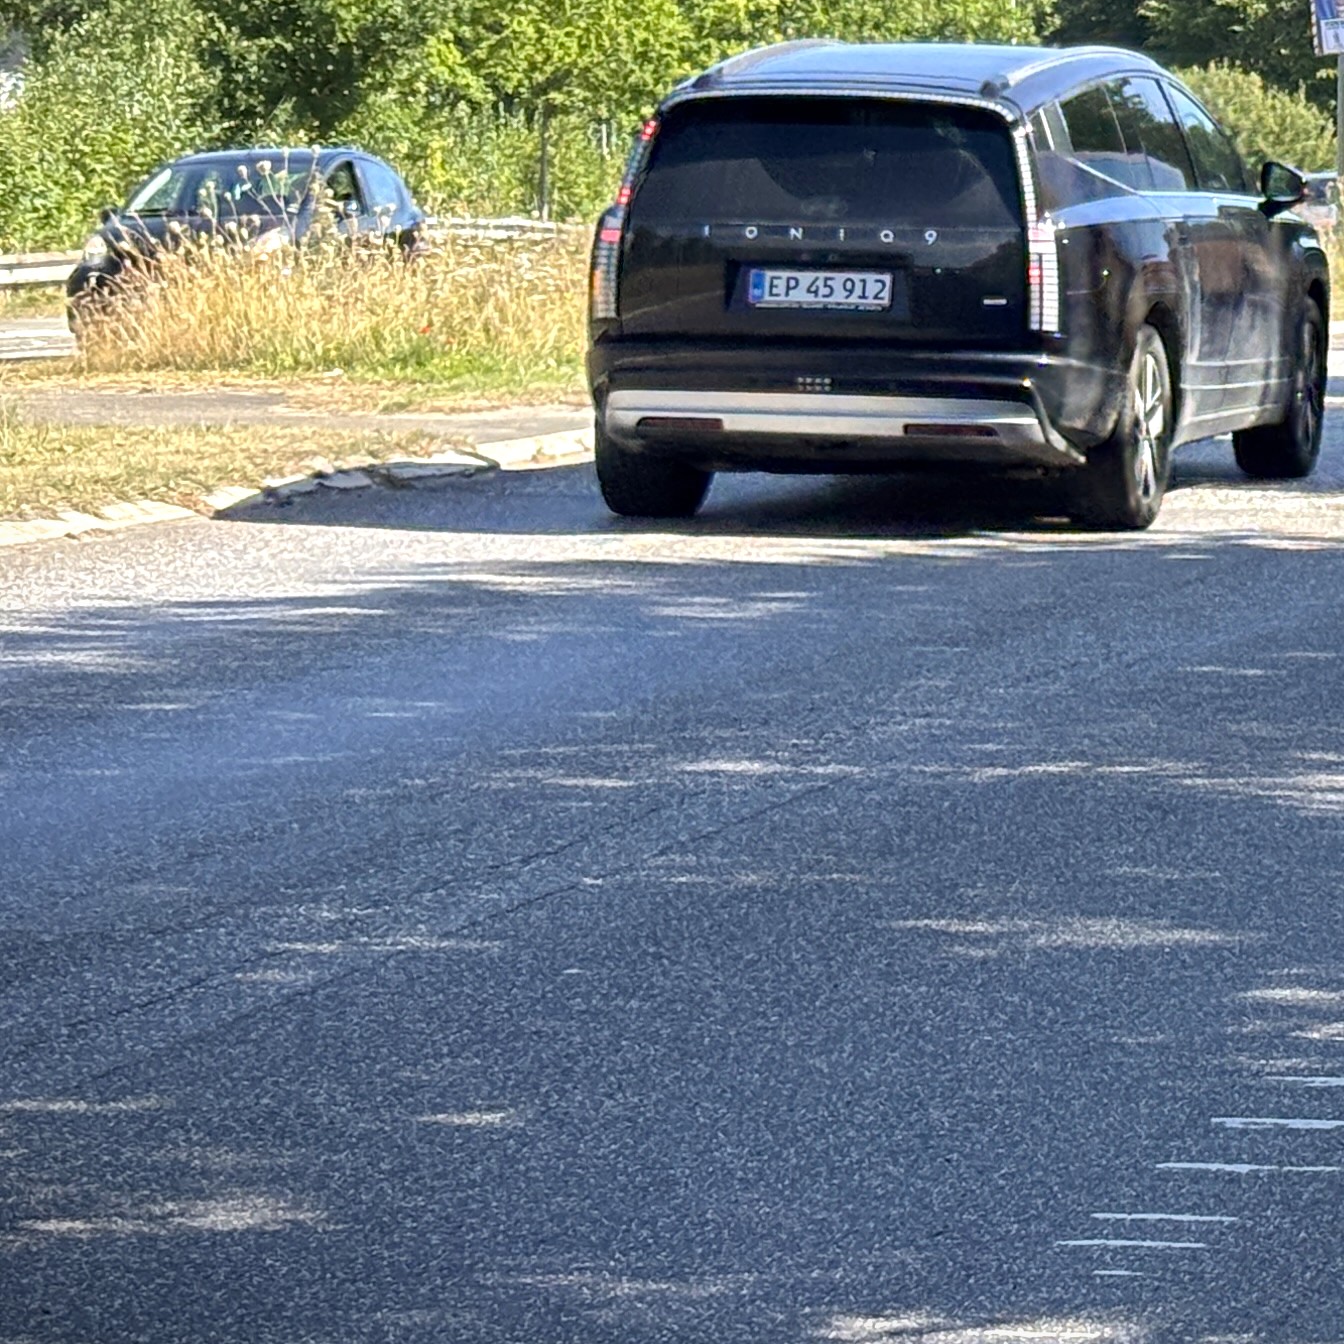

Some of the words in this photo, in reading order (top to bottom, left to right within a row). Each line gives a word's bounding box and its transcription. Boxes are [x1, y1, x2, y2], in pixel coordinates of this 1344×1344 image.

[768, 276, 799, 297] EP
[806, 276, 835, 298] 45
[843, 277, 887, 301] 912
